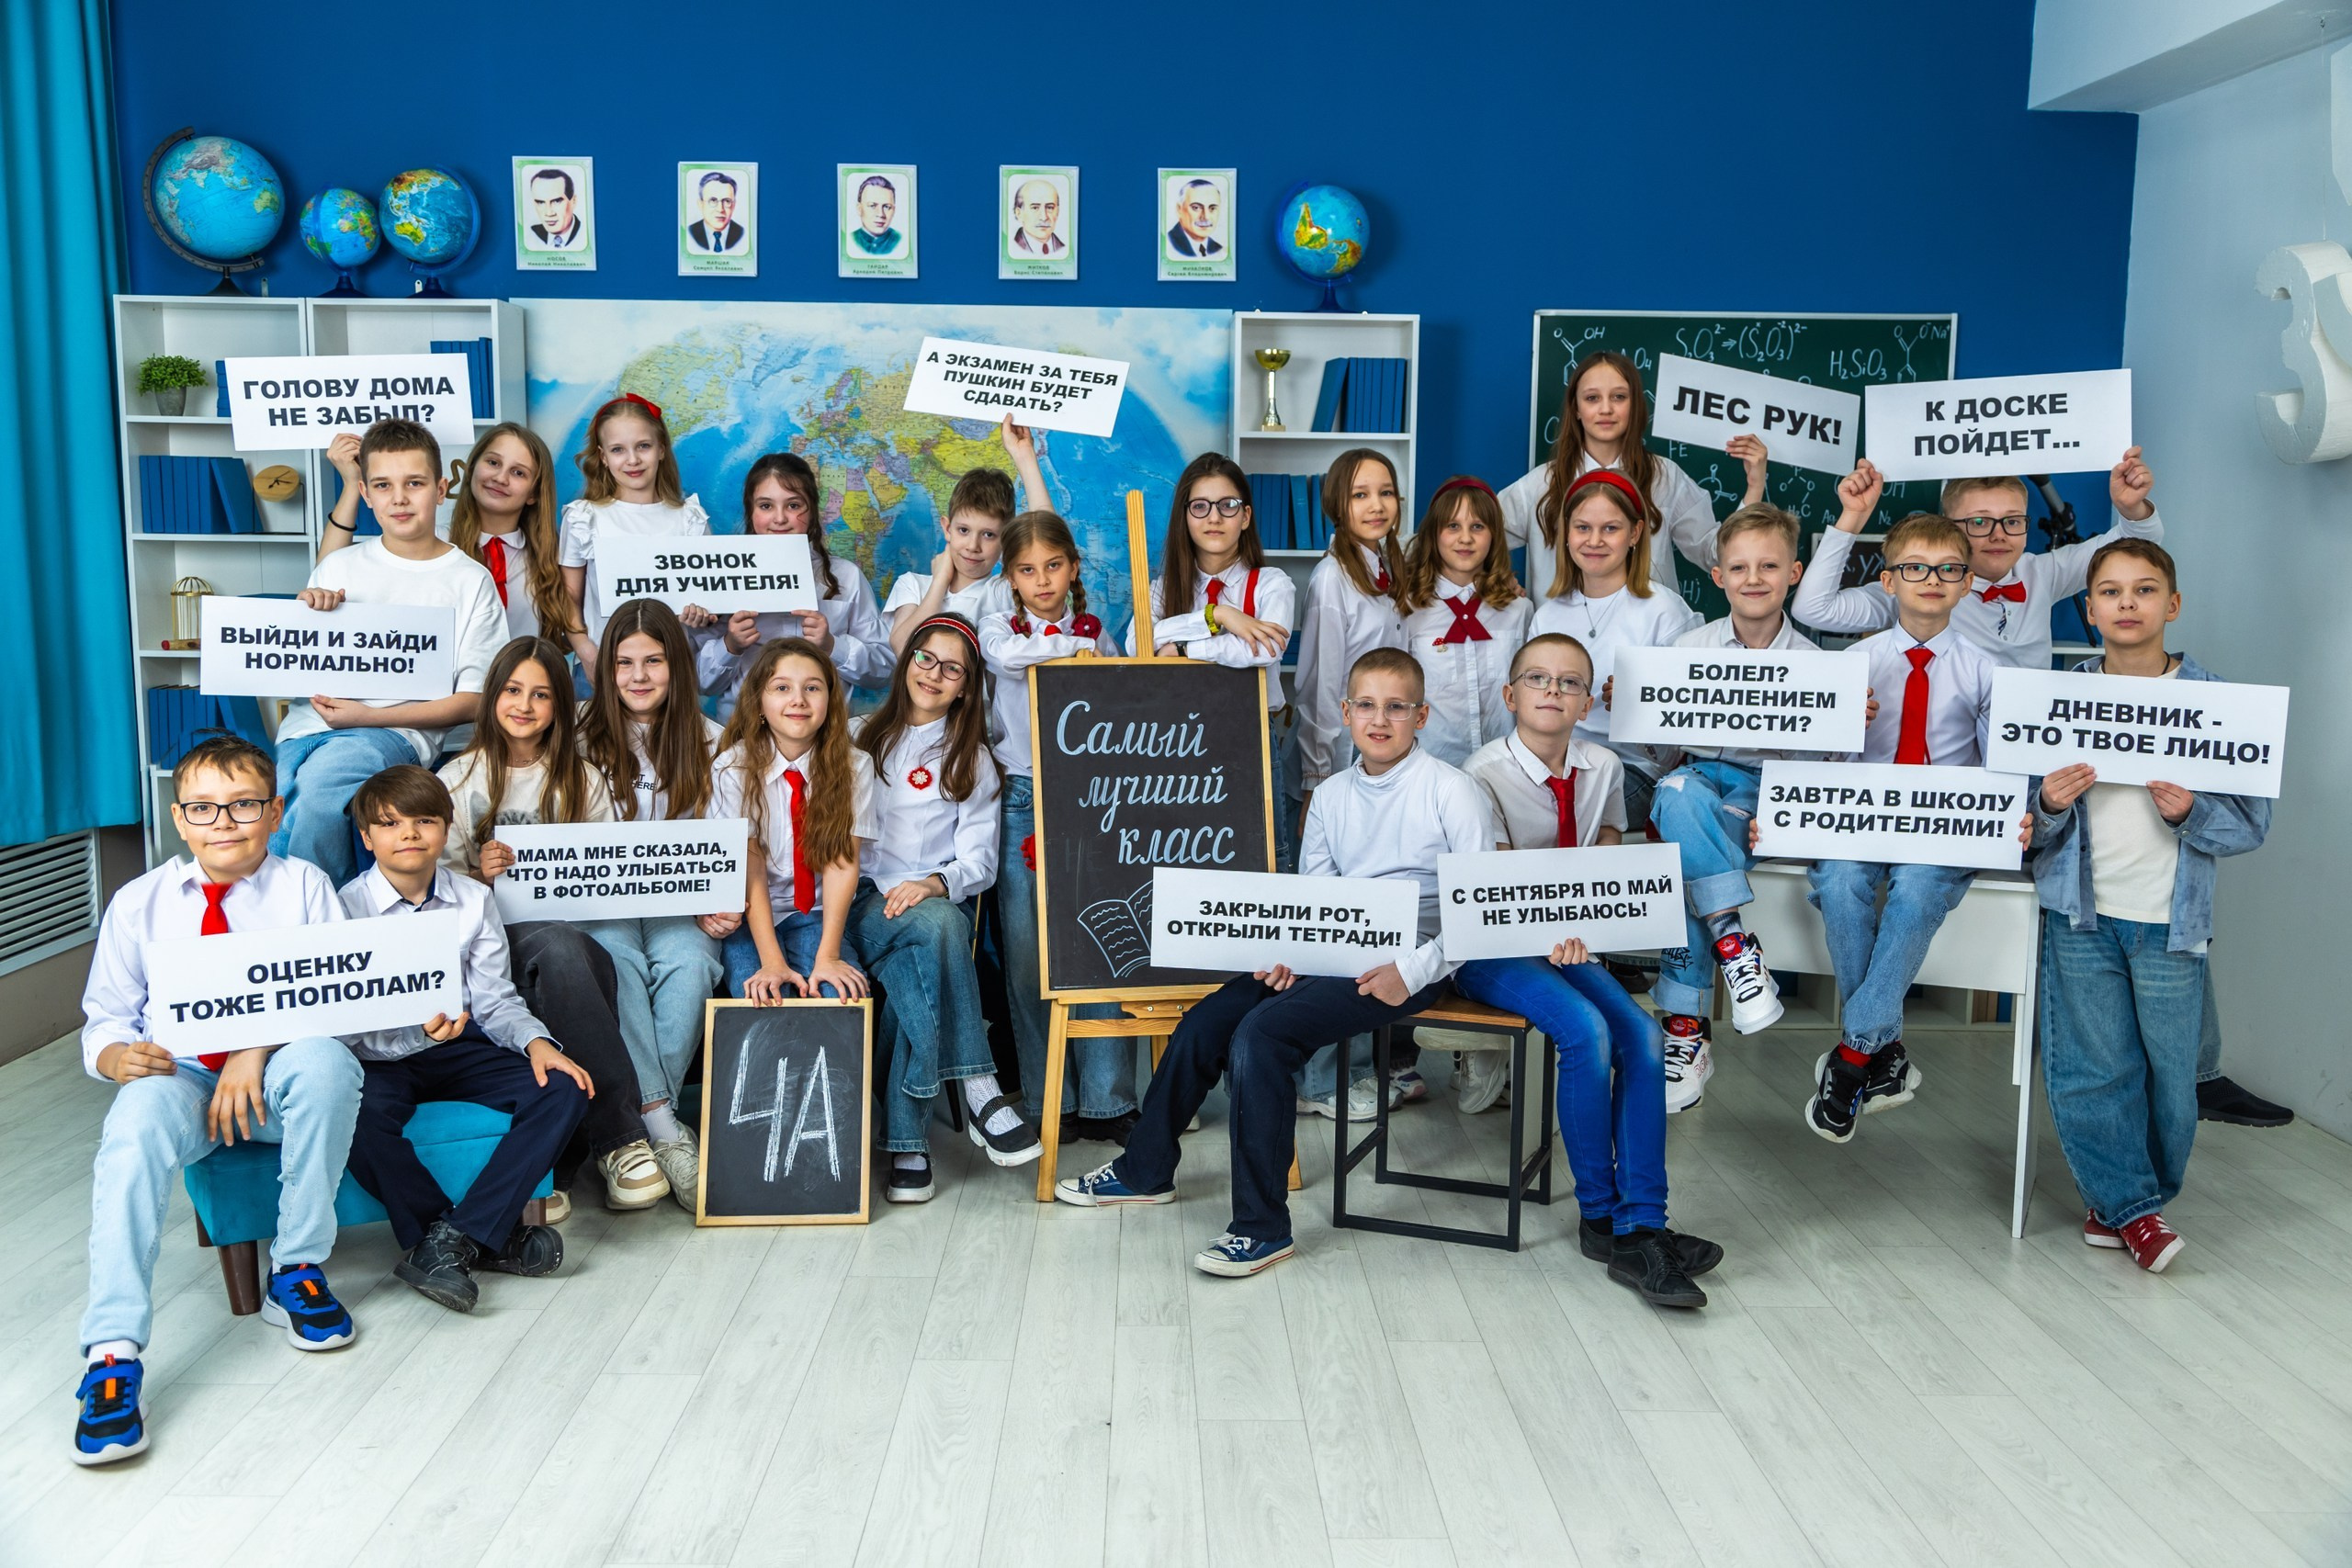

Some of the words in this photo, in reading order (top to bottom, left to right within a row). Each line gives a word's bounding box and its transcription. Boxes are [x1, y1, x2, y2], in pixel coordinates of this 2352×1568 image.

[926, 351, 939, 363] А
[944, 353, 1035, 375] ЭКЗАМЕН
[1038, 365, 1062, 379] ЗА
[1069, 368, 1118, 387] ТЕБЯ
[243, 378, 360, 400] ГОЛОВУ
[369, 377, 455, 400] ДОМА
[944, 369, 1025, 391] ПУШКИН
[1030, 380, 1093, 400] БУДЕТ
[964, 389, 1064, 412] СДАВАТЬ?
[1926, 400, 1946, 422] К
[1954, 392, 2068, 424] ДОСКЕ
[268, 407, 308, 427] НЕ
[317, 404, 435, 425] ЗАБЫЛ?
[1672, 385, 1751, 425] ЛЕС
[1762, 403, 1842, 446] РУК!
[1914, 427, 2080, 457] ПОЙДЕТ...
[654, 553, 757, 570] ЗВОНОК
[615, 577, 670, 597] ДЛЯ
[675, 574, 799, 592] УЧИТЕЛЯ!
[220, 625, 319, 649] ВЫЙДИ
[328, 631, 345, 648] И
[353, 629, 437, 654] ЗАЙДИ
[245, 652, 414, 674] НОРМАЛЬНО!
[1688, 663, 1790, 682] БОЛЕЛ?
[1640, 686, 1837, 709] ВОСПАЛЕНИЕМ
[1659, 710, 1812, 733] ХИТРОСТИ?
[2048, 698, 2204, 729] ДНЕВНИК
[1057, 700, 1207, 758] Самый
[2001, 722, 2063, 746] ЭТО
[2072, 728, 2155, 755] ТВОЕ
[2164, 736, 2270, 766] ЛИЦО!
[1078, 765, 1227, 832] лучший
[1770, 785, 1874, 807] ЗАВТРА
[1883, 789, 1901, 807] В
[1910, 790, 2016, 812] ШКОЛУ
[1773, 810, 1792, 828] С
[1799, 811, 2005, 839] РОДИТЕЛЯМИ!
[517, 847, 579, 863] МАМА
[583, 845, 627, 860] МНЕ
[632, 841, 728, 858] СКАЗАЛА,
[1117, 826, 1236, 865] класс
[506, 867, 548, 882] ЧТО
[554, 864, 611, 882] НАДО
[616, 859, 737, 877] УЛЫБАТЬСЯ
[534, 886, 548, 900] В
[552, 878, 711, 898] ФОТОАЛЬБОМЕ!
[1452, 888, 1466, 905] С
[1473, 882, 1585, 904] СЕНТЯБРЯ
[1591, 880, 1622, 897] ПО
[1627, 874, 1673, 896] МАЙ
[1199, 900, 1312, 921] ЗАКРЫЛИ
[1318, 907, 1371, 928] РОТ,
[1482, 908, 1511, 926] НЕ
[1516, 901, 1647, 924] УЛЫБАЮСЬ!
[1167, 919, 1281, 941] ОТКРЫЛИ
[1287, 926, 1402, 949] ТЕТРАДИ!
[247, 951, 373, 985] ОЦЕНКУ
[169, 992, 266, 1023] ТОЖЕ
[275, 970, 447, 1010] ПОПОЛАМ?
[729, 1039, 841, 1182] 4А
